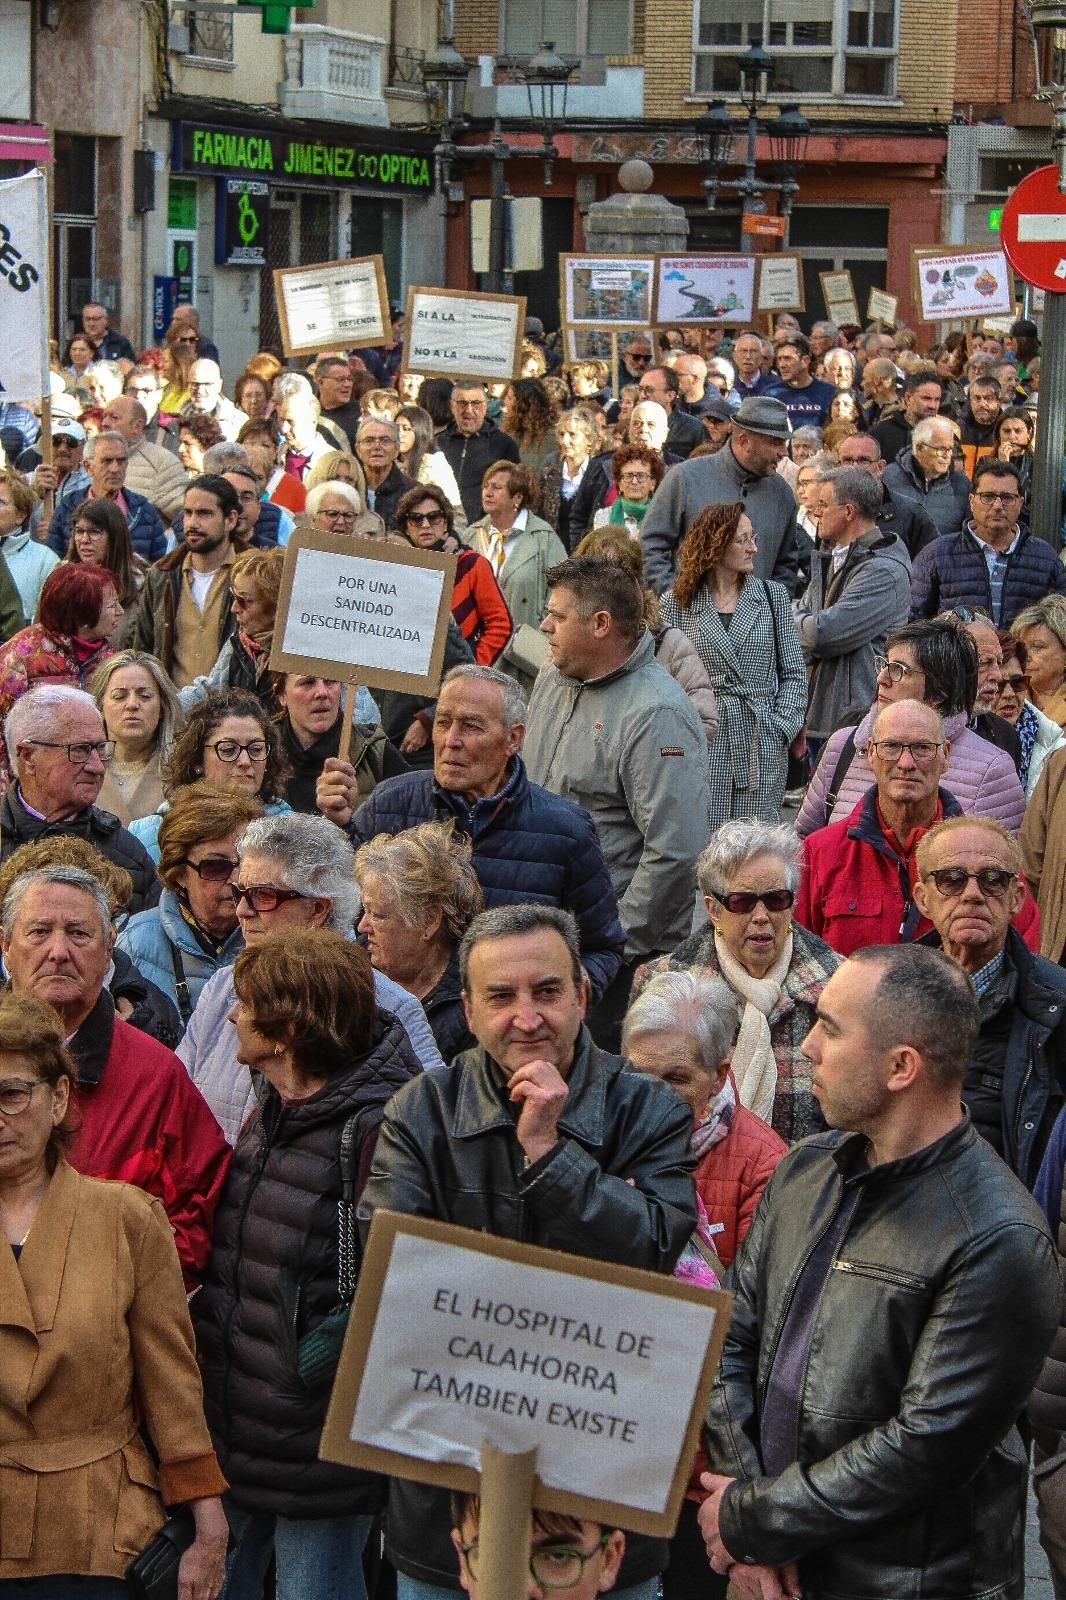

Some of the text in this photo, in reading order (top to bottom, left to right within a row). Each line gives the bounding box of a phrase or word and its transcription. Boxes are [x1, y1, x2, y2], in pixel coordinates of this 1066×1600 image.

[193, 130, 273, 171] FARMACIA
[379, 154, 429, 186] OPTICA
[307, 316, 377, 331] SE DEFIENDE
[431, 311, 439, 320] A
[442, 312, 456, 322] LA
[414, 346, 431, 356] NO
[433, 349, 441, 358] A
[443, 350, 458, 360] LA
[338, 575, 398, 597] POR UNA
[334, 596, 394, 617] SANIDAD
[300, 612, 421, 643] DESCENTRALIZADA
[433, 1288, 654, 1359] EL HOSPITAL DE
[447, 1335, 618, 1396] CALAHORRA
[410, 1367, 640, 1444] TAMBIEN EXISTE
